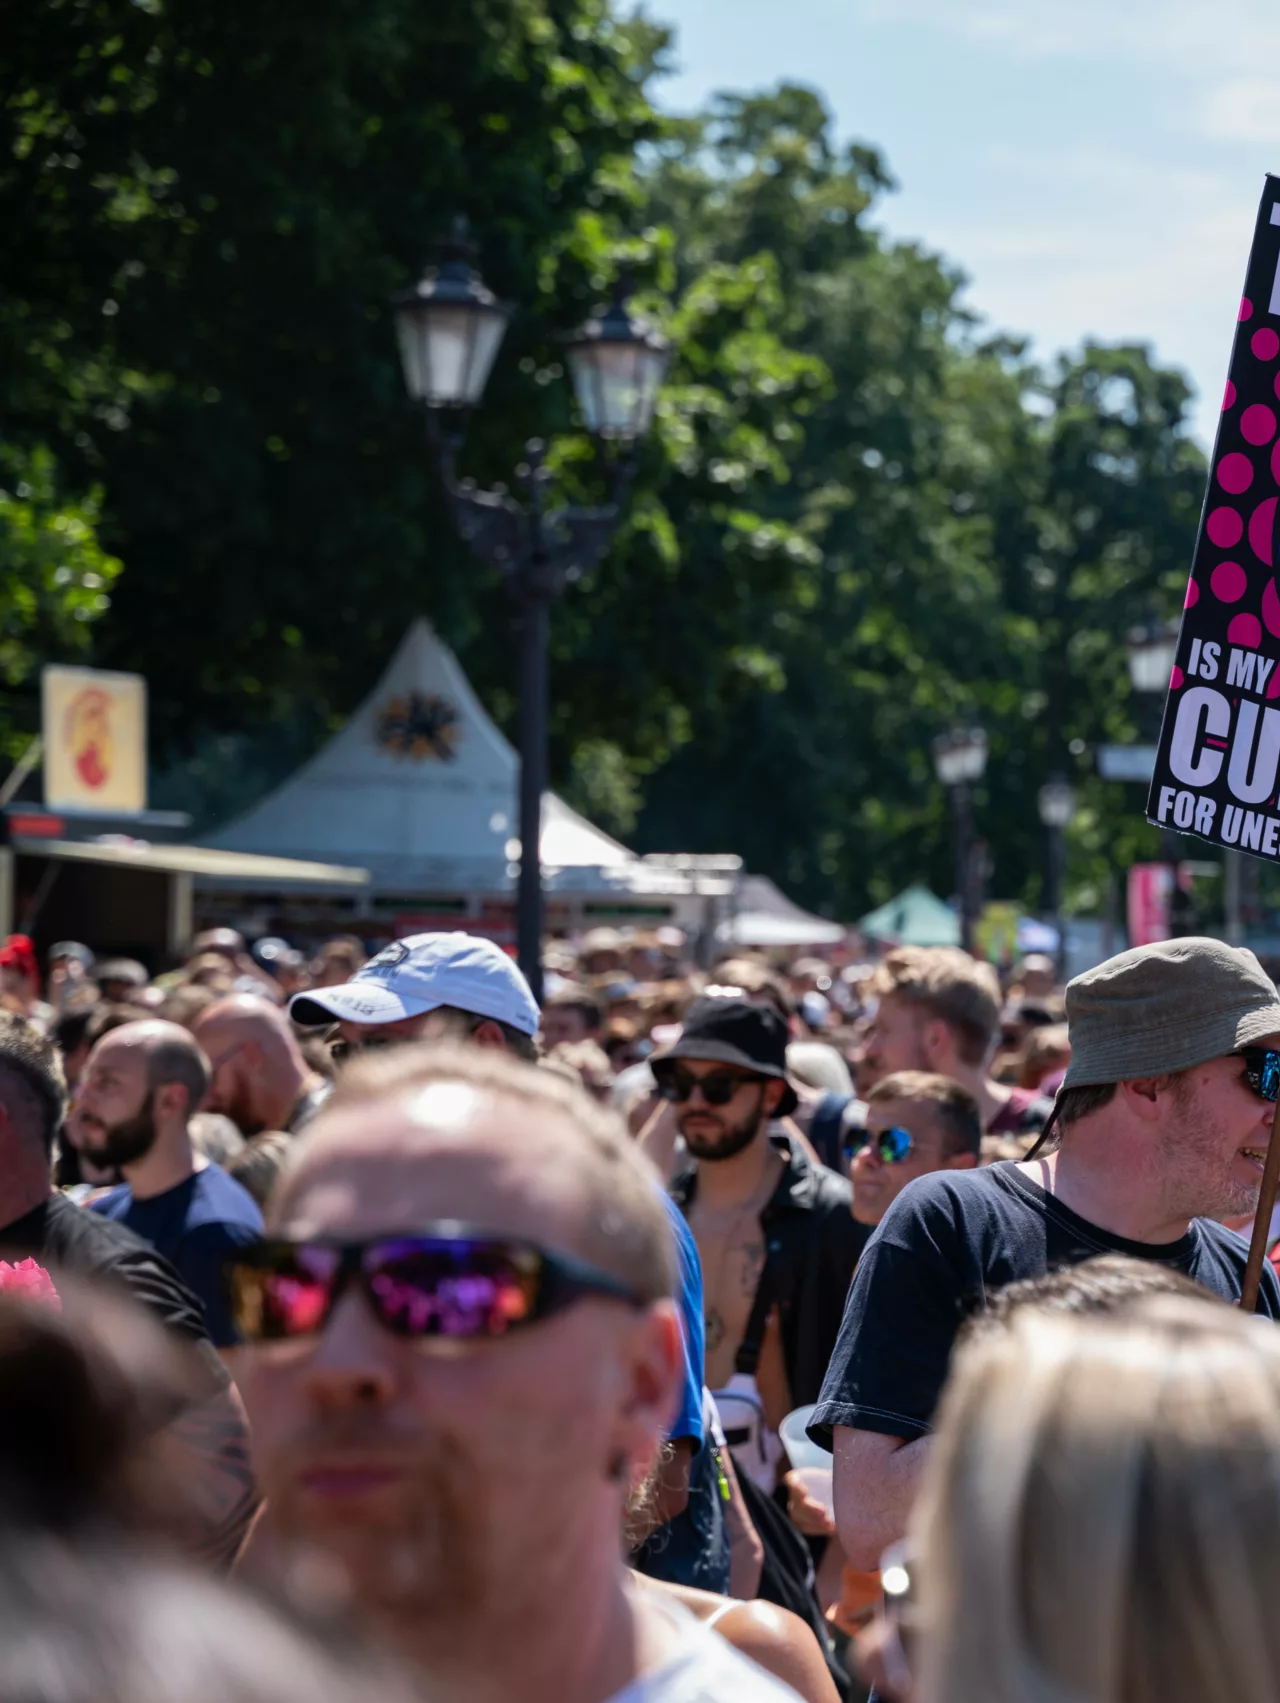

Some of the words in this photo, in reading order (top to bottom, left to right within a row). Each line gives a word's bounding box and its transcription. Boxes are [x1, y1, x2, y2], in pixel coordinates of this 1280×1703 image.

[1187, 637, 1220, 680] IS
[1225, 648, 1275, 695] MY
[1157, 785, 1217, 836] FOR
